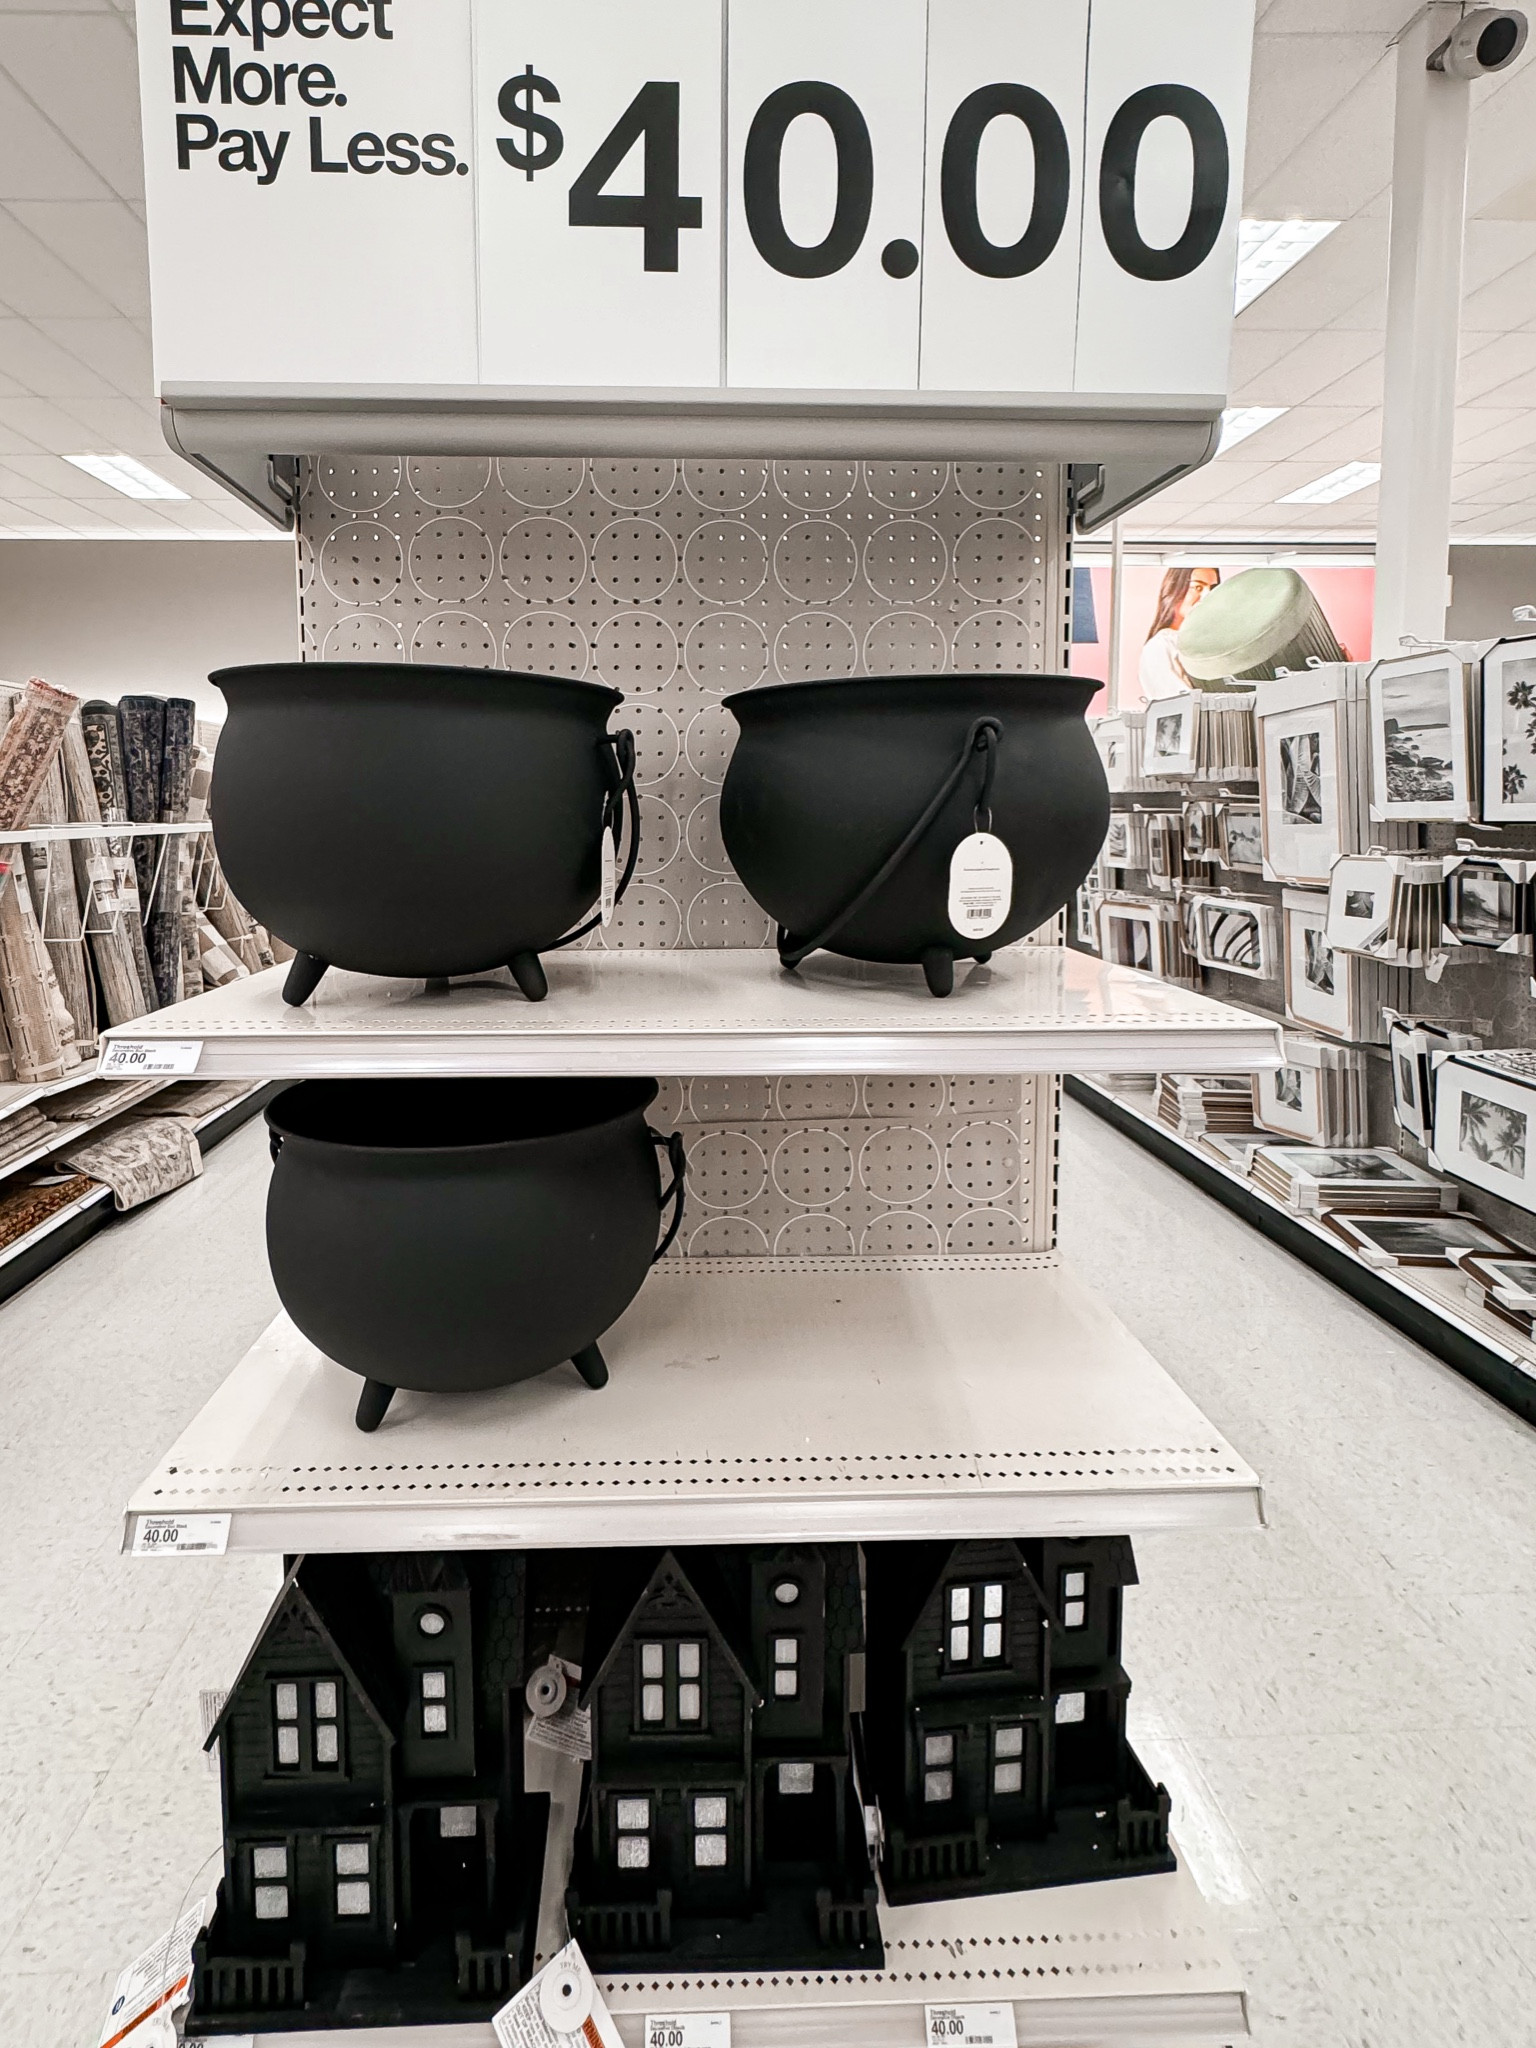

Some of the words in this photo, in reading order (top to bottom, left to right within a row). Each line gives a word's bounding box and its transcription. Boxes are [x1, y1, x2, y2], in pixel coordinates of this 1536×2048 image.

[170, 0, 393, 51] Expect
[172, 46, 347, 107] More.
[175, 113, 290, 185] Pay
[309, 117, 468, 176] Less.
[109, 1052, 147, 1064] 40.00
[143, 1528, 179, 1543] 40.00
[931, 2020, 964, 2035] 40.00
[650, 2031, 683, 2047] 40.00
